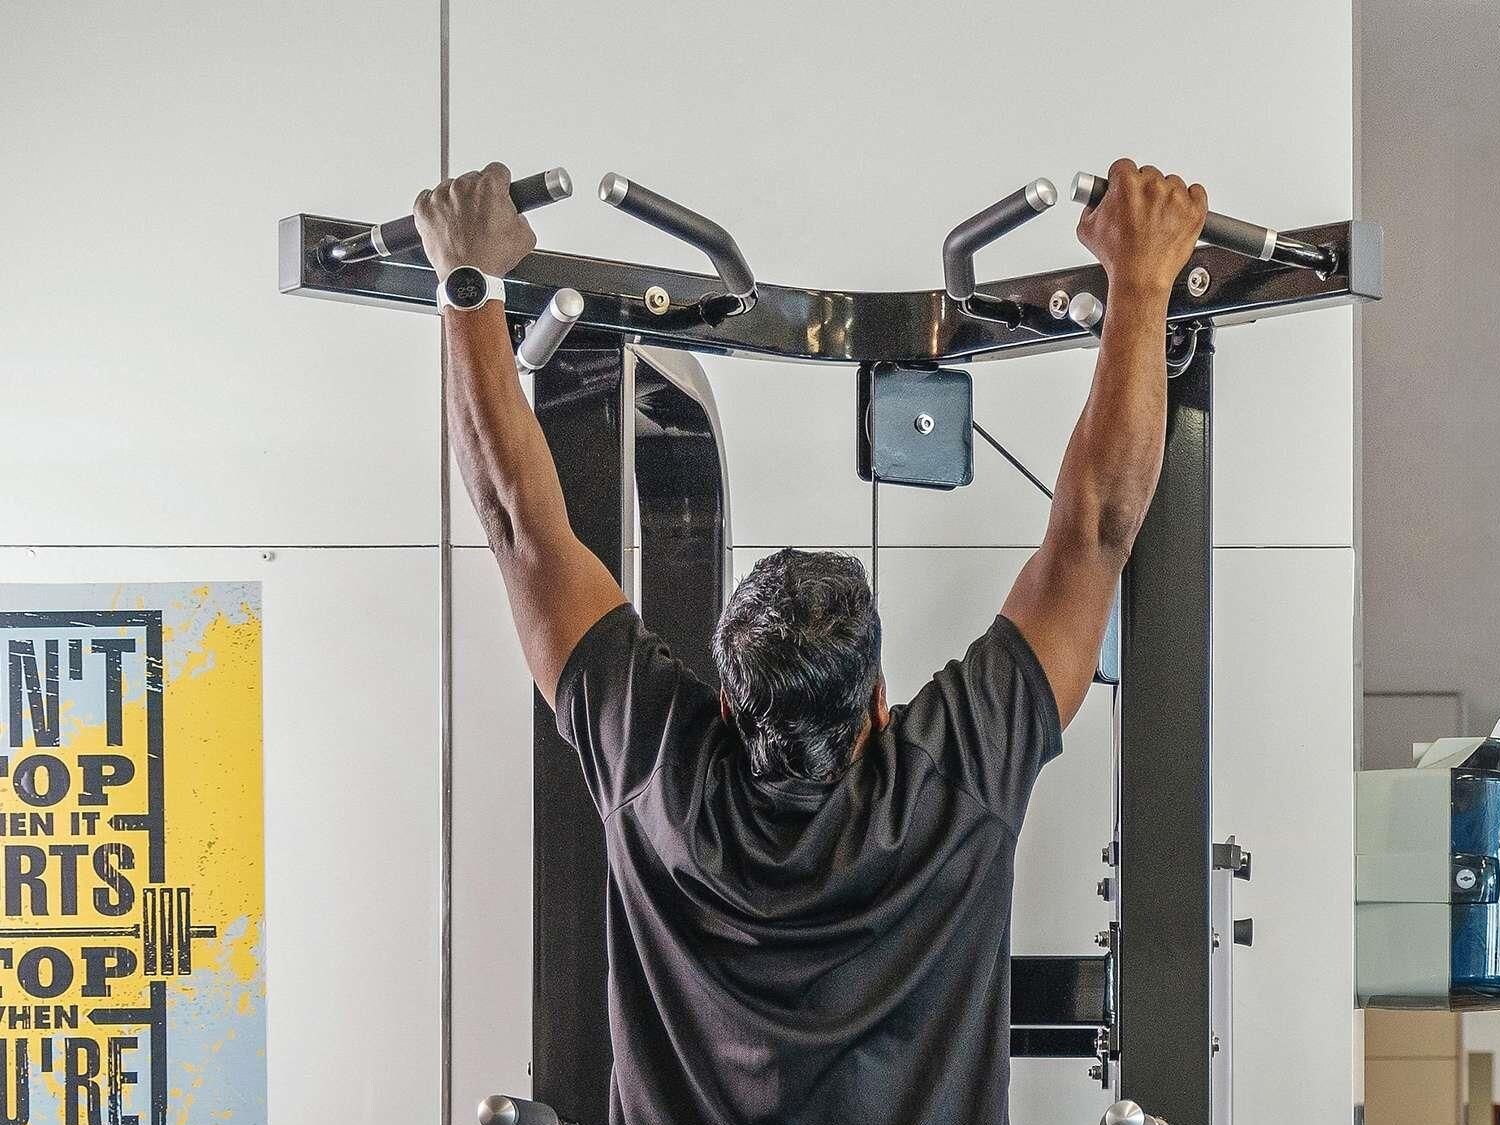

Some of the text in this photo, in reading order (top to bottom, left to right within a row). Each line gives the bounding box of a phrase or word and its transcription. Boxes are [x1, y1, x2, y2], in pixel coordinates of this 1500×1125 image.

[0, 754, 135, 807] OP
[70, 811, 100, 836] IT
[5, 843, 135, 917] RTS
[0, 1005, 78, 1029] HEN
